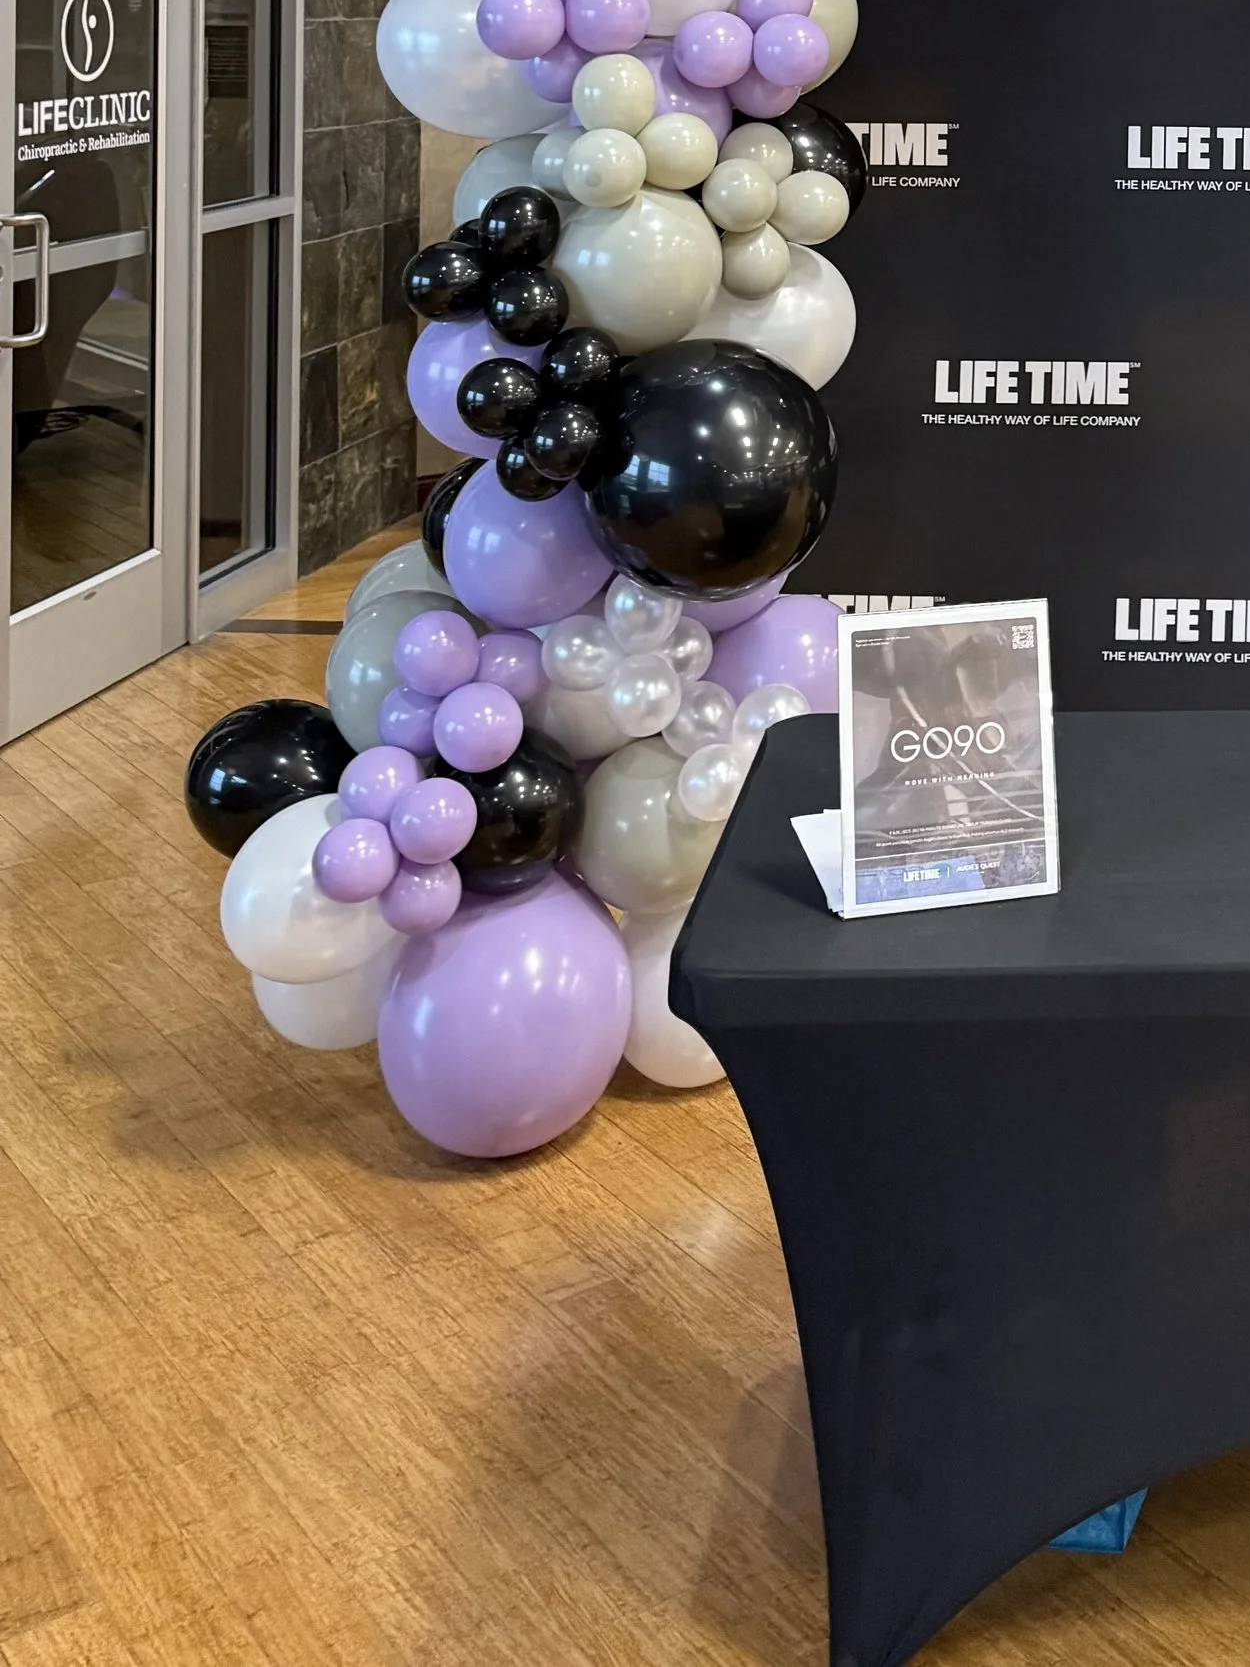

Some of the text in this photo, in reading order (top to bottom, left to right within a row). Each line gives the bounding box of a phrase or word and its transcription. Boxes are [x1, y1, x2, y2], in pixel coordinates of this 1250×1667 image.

[18, 90, 151, 136] LIFECLINIC
[18, 130, 151, 161] Chiropractic & Rehabilitation
[1128, 126, 1210, 169] LIFE
[871, 176, 961, 188] LIFE COMPANY
[1114, 179, 1139, 190] THE
[1140, 179, 1195, 191] HEALTHY
[1196, 180, 1224, 191] WAY
[1225, 180, 1243, 192] OF
[935, 360, 1019, 403] LIFE
[1025, 362, 1129, 404] TIME
[921, 413, 1142, 427] THE HEALTHY WAY OF LIFE COMPANY
[1115, 598, 1200, 641] LIFE
[1101, 650, 1127, 662] THE
[1128, 651, 1184, 663] HEALTHY
[1184, 652, 1213, 663] WAY
[1213, 652, 1233, 663] OF
[890, 721, 1005, 763] GO90
